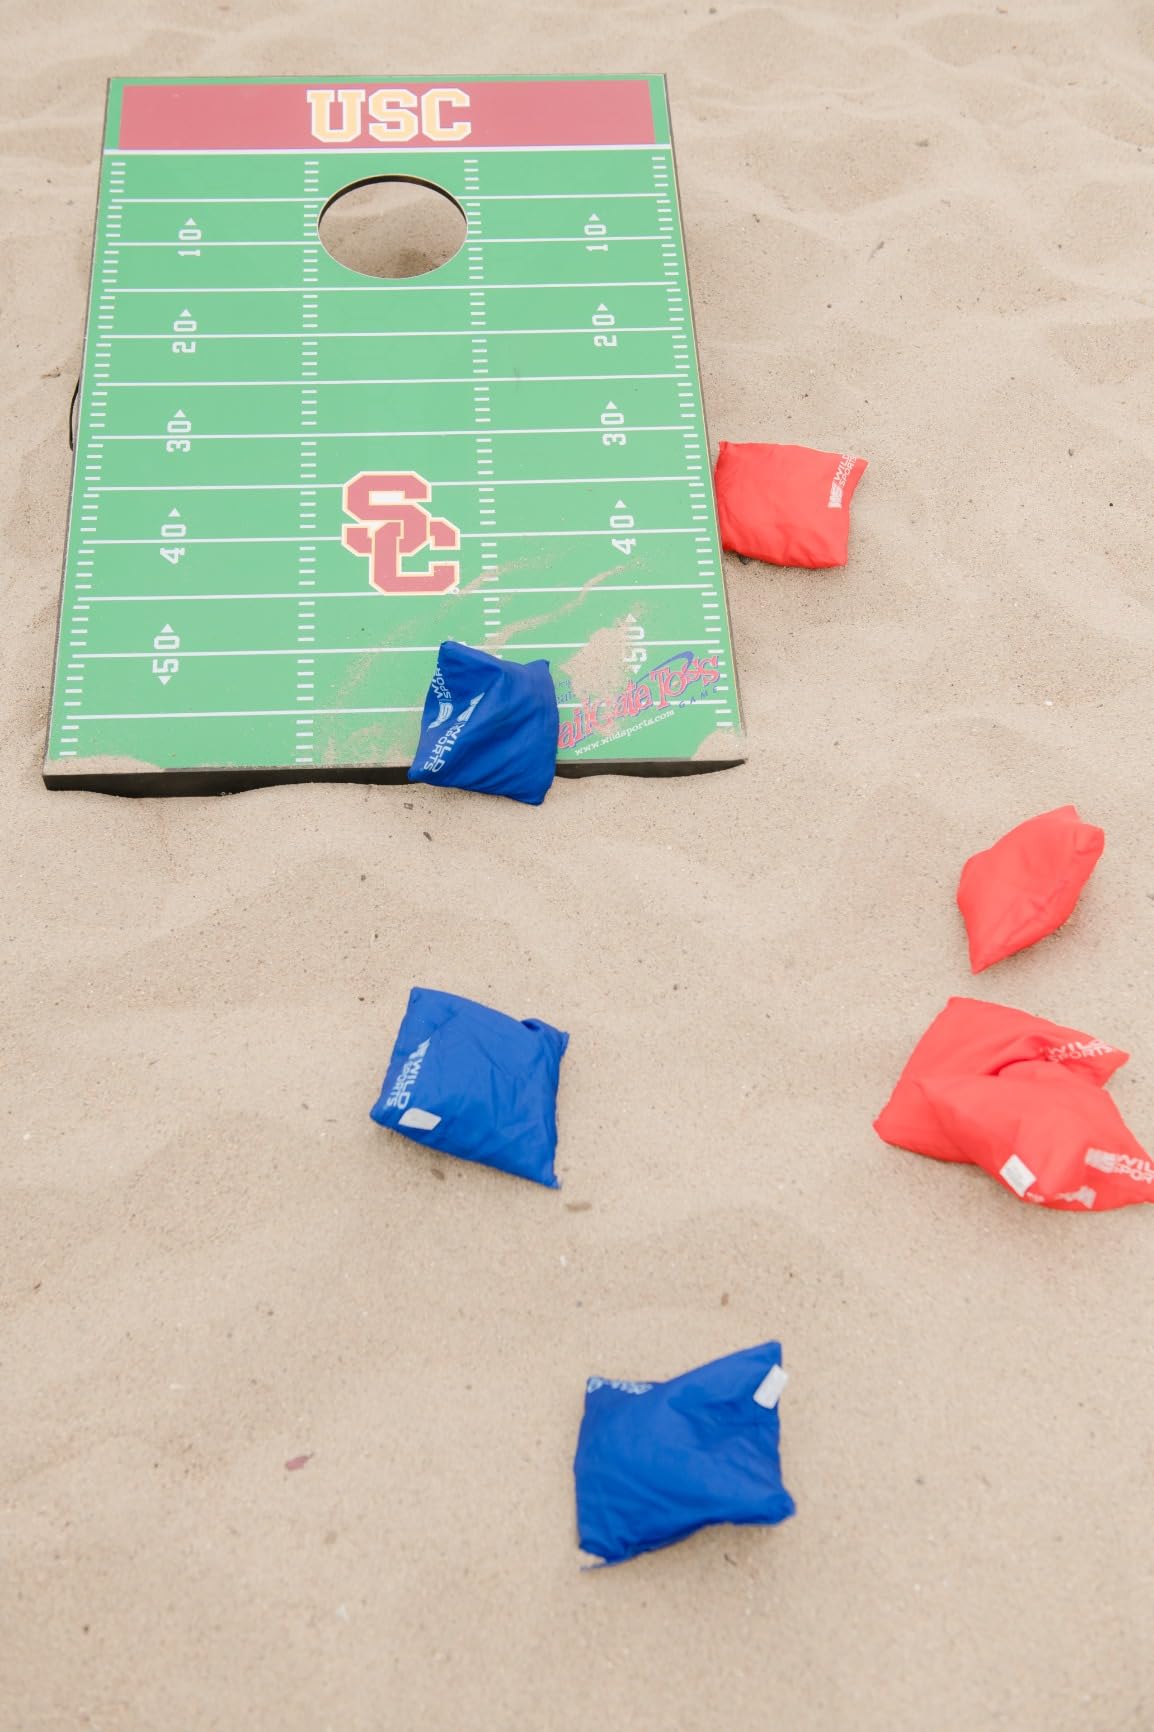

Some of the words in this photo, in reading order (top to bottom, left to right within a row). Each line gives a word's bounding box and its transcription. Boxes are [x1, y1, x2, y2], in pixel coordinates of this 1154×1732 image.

[306, 88, 472, 143] USC
[177, 229, 202, 257] 10
[584, 224, 609, 251] 10
[172, 320, 197, 353] 20
[592, 314, 617, 347] 20
[166, 420, 192, 452] 30
[600, 413, 627, 446] 30
[160, 524, 187, 564] 40
[610, 515, 637, 555] 40
[152, 635, 180, 673] 50
[623, 626, 648, 663] 50
[557, 679, 654, 750] ailGate
[575, 709, 676, 756] www.wildsports.com
[433, 721, 465, 773] WILD
[397, 1058, 423, 1110] WILD
